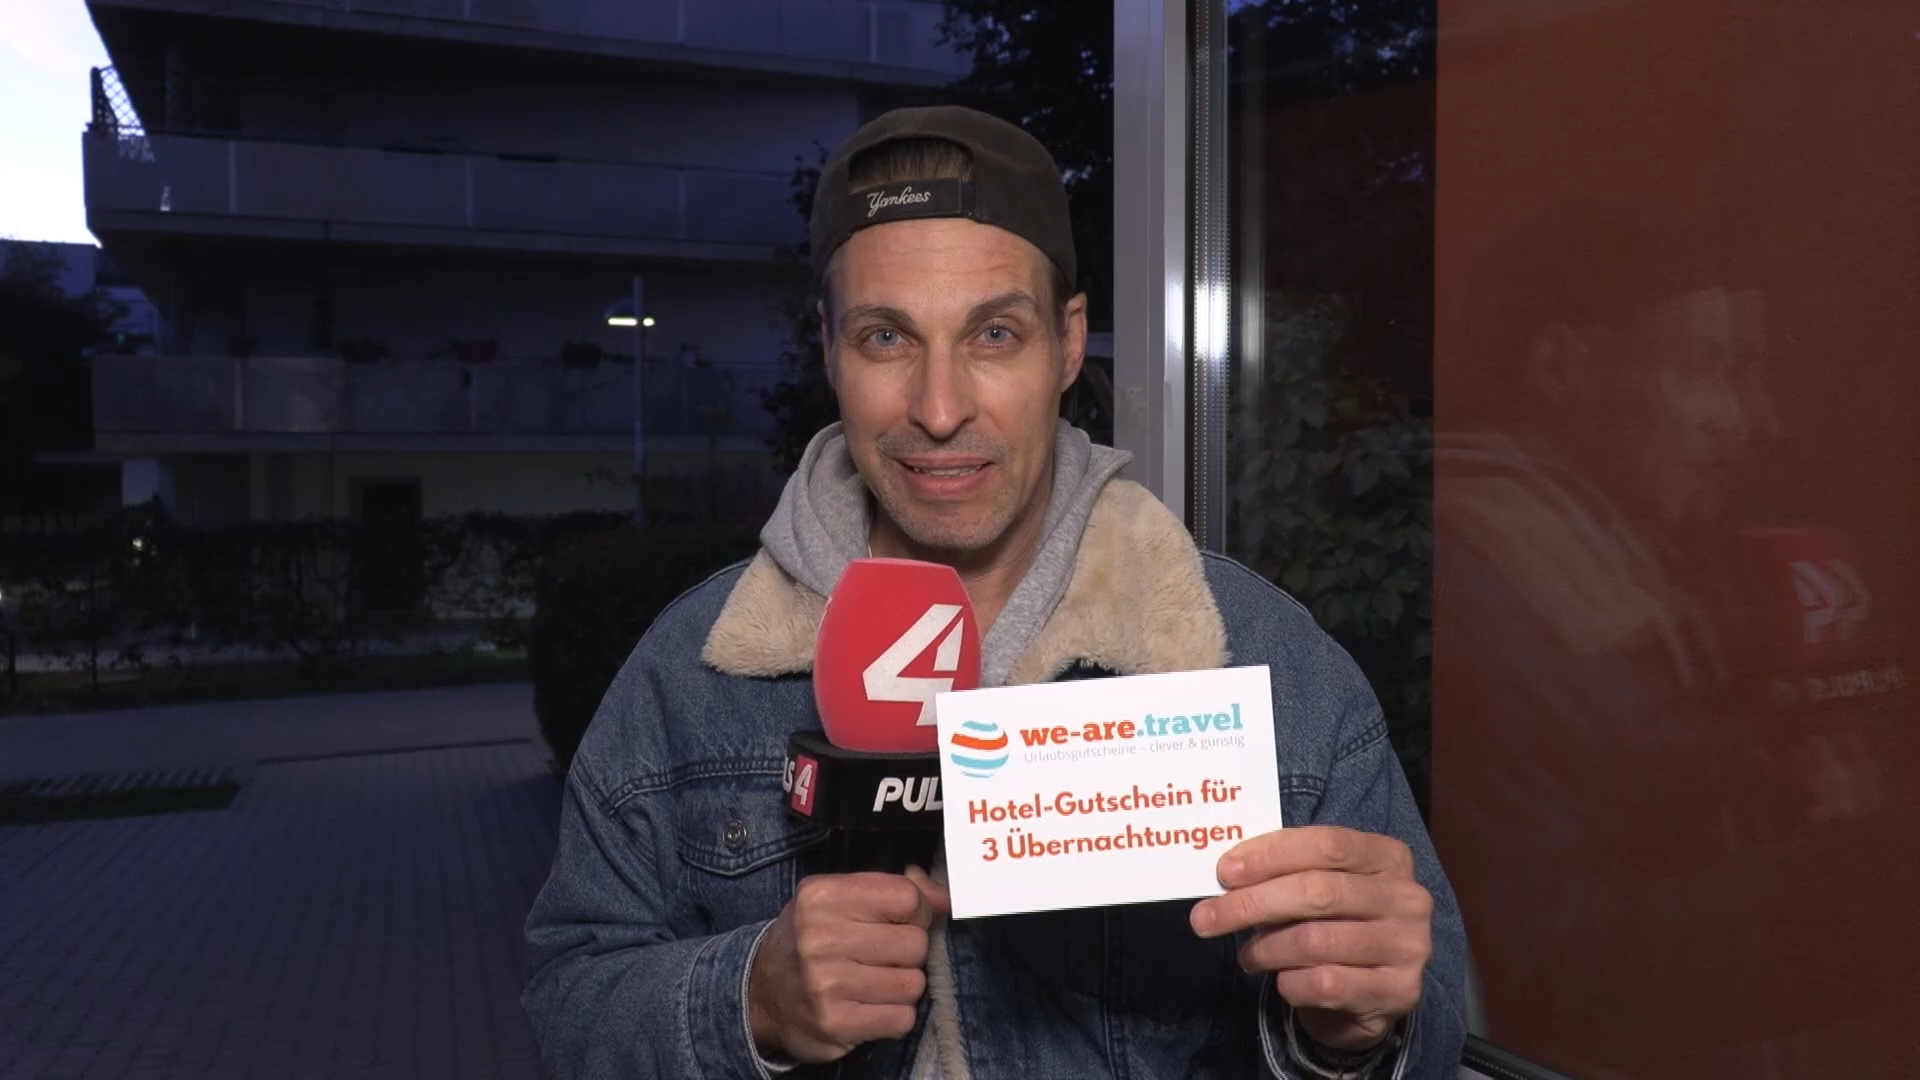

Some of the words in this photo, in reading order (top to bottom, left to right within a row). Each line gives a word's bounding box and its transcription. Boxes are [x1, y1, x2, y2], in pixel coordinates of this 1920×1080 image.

[866, 185, 932, 218] Yankees
[862, 603, 964, 727] 4
[1020, 703, 1243, 747] we-are.travel
[1149, 738, 1184, 753] clever
[1188, 736, 1197, 750] &
[968, 783, 1193, 823] Hotel-Gutschein
[1200, 779, 1242, 802] für
[981, 836, 999, 862] 3
[1006, 823, 1243, 860] Übernachtungen
